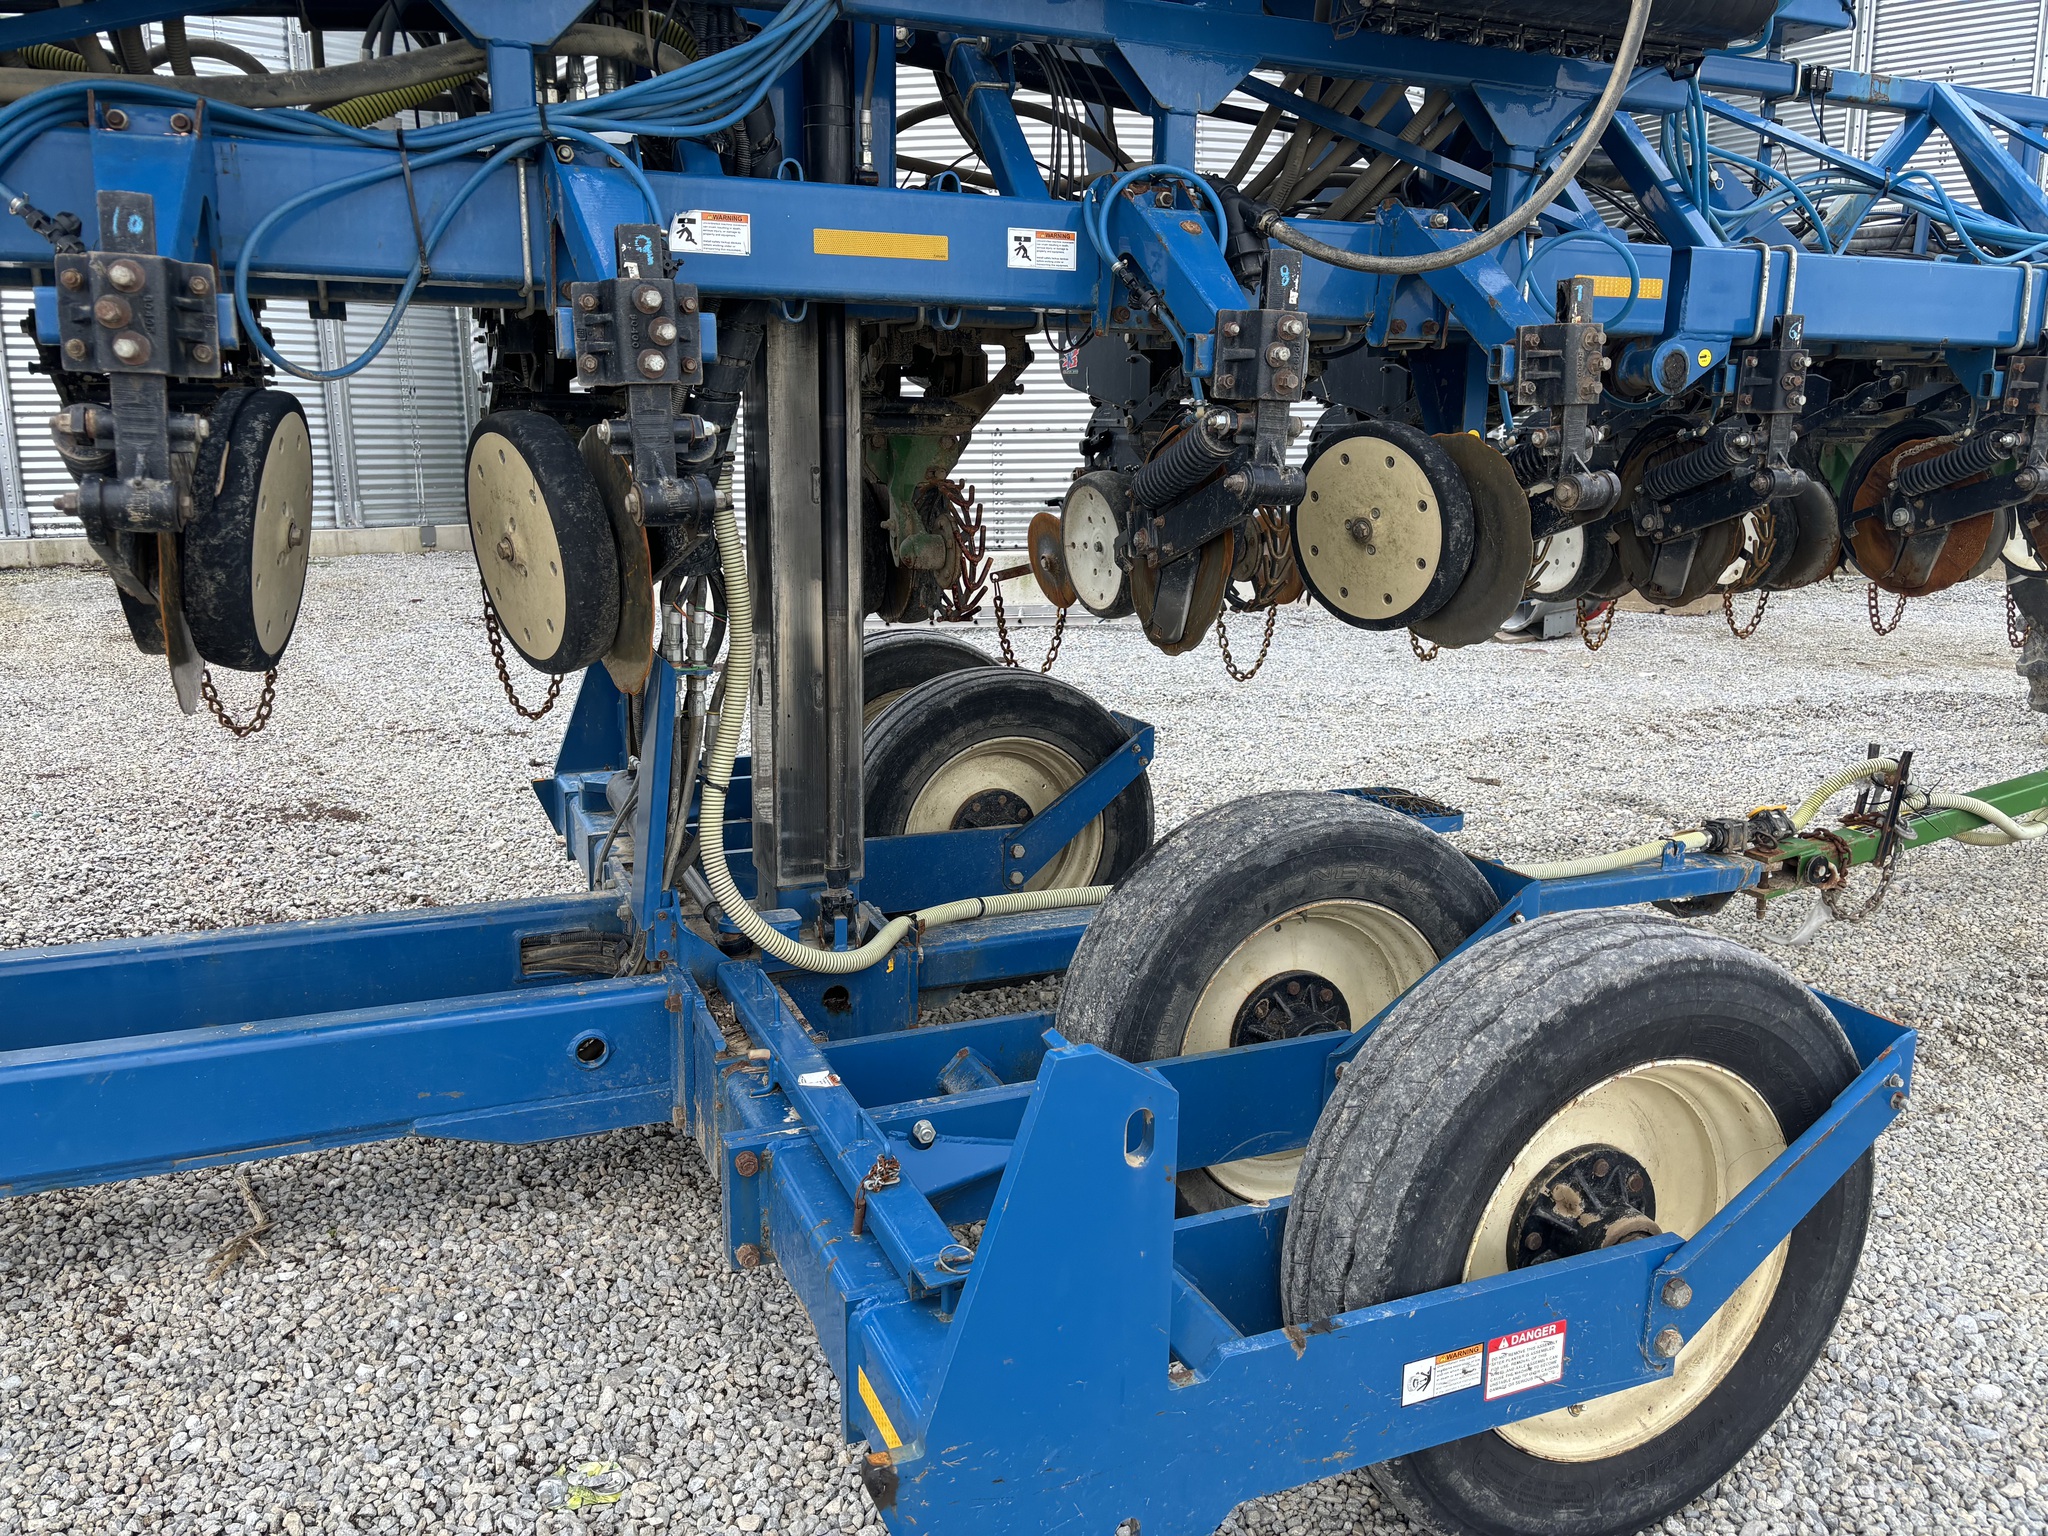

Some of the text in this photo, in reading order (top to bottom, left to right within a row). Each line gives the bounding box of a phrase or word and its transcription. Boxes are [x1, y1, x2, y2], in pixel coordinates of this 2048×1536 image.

[112, 206, 144, 235] 10
[634, 234, 654, 266] 9
[1280, 264, 1290, 286] 8
[1511, 1324, 1556, 1344] DANGER
[1446, 1346, 1480, 1360] WARNING
